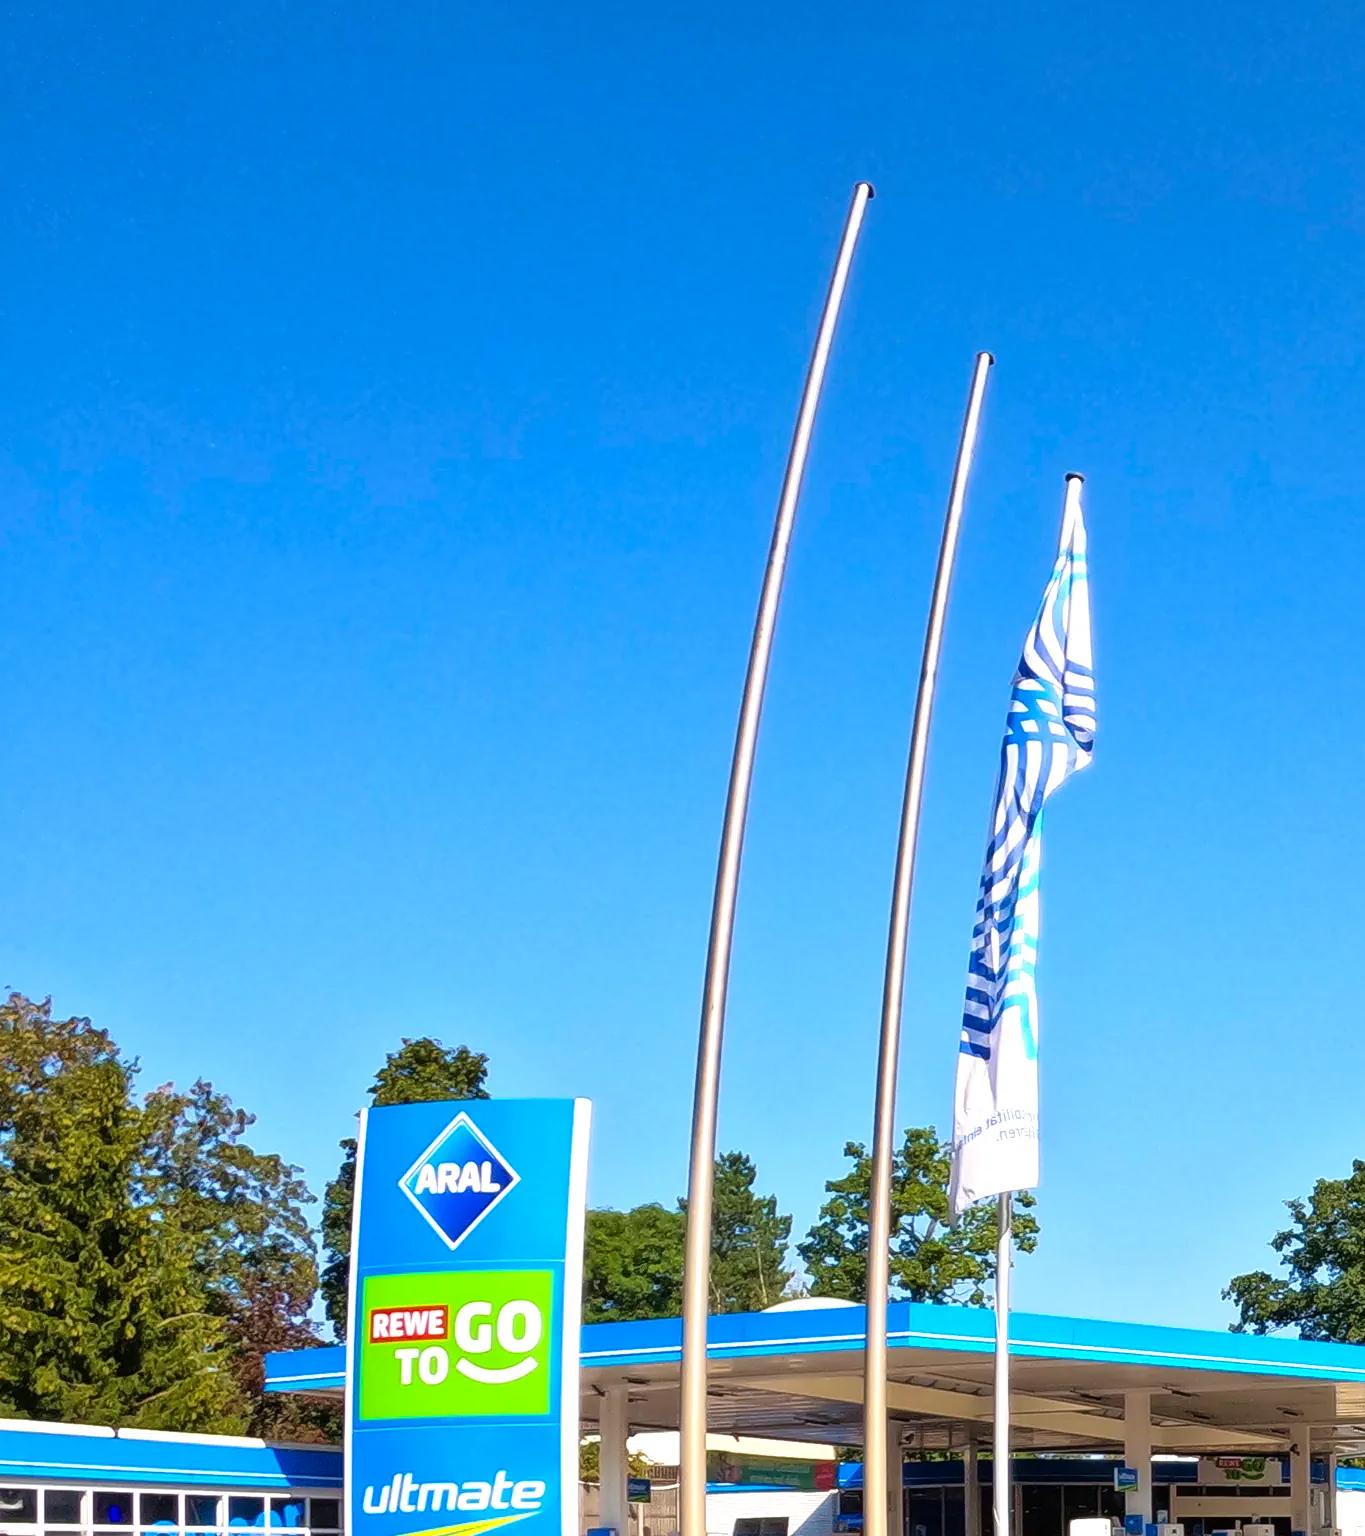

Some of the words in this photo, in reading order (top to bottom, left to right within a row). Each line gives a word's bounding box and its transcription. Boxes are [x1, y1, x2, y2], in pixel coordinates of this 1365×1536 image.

[414, 1161, 501, 1194] ARAL
[372, 1309, 445, 1339] REWE
[394, 1345, 449, 1386] TO
[454, 1299, 543, 1354] GO
